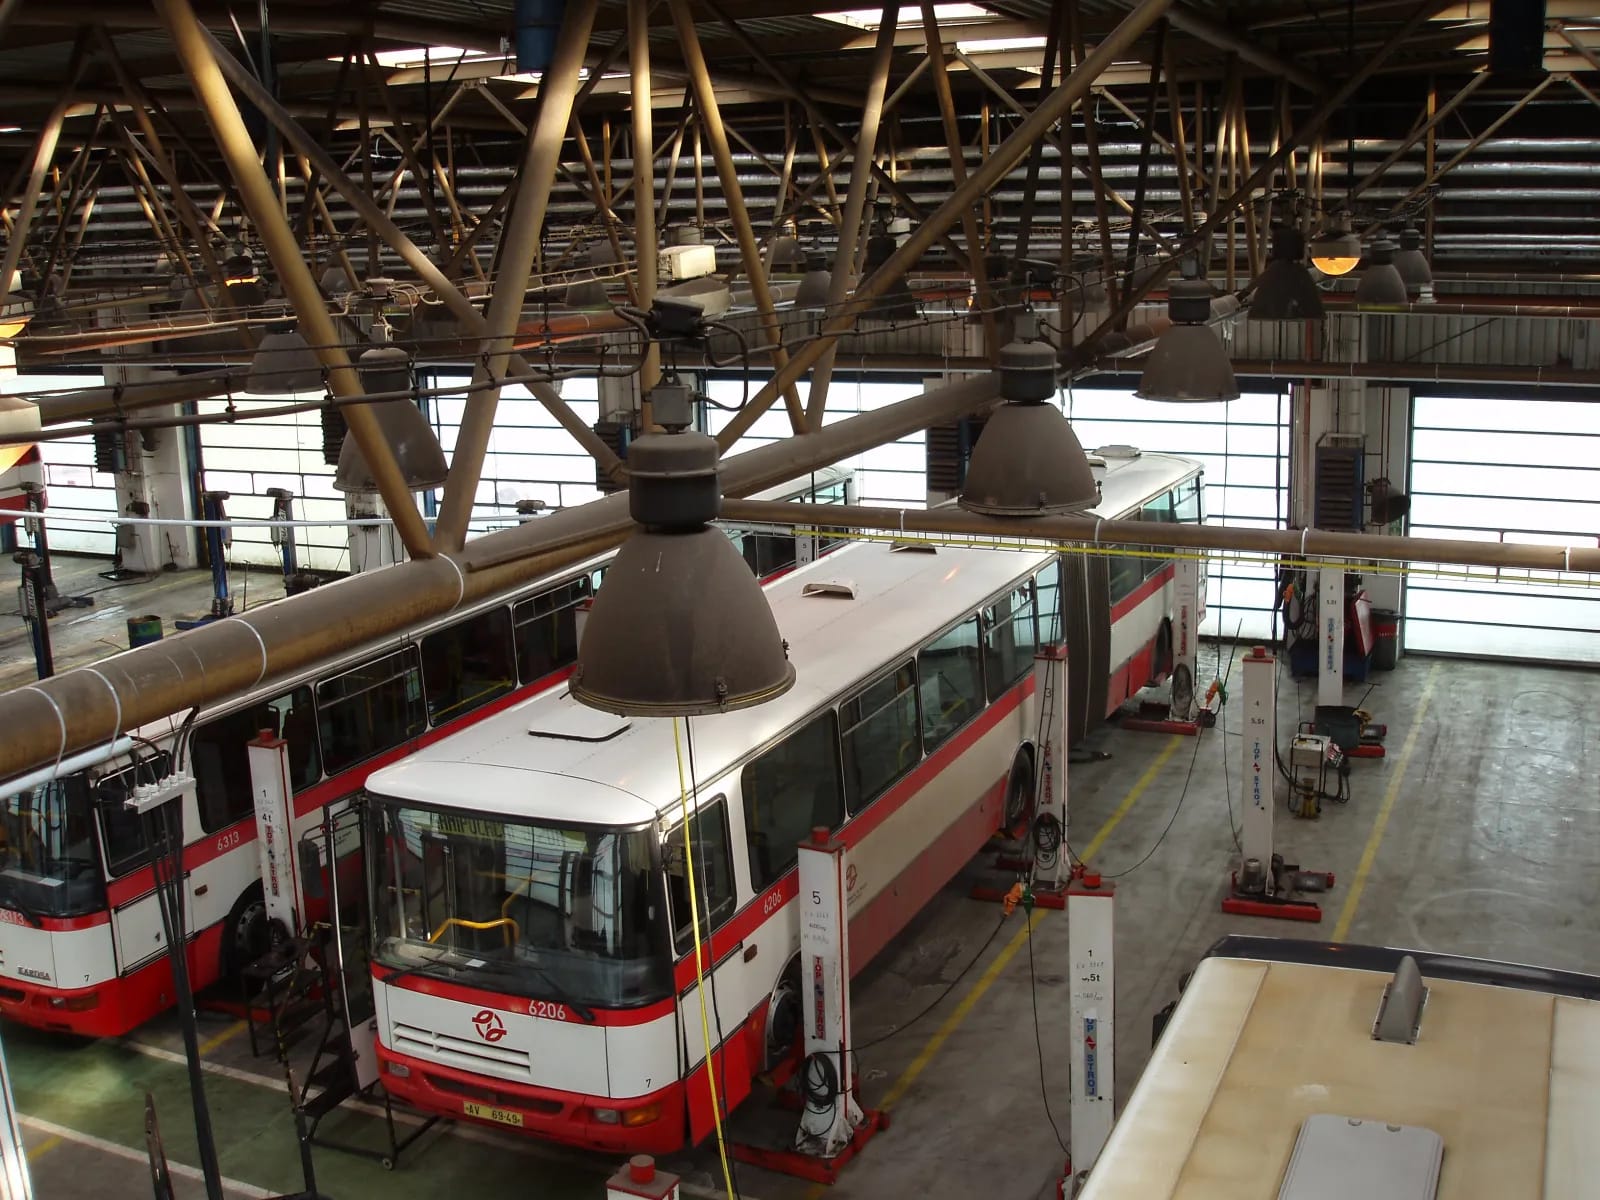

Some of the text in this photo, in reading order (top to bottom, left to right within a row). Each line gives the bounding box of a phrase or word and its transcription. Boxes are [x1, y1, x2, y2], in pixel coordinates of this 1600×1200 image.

[217, 831, 240, 851] 6313
[763, 888, 782, 915] 6206
[811, 890, 821, 905] 5
[84, 974, 90, 983] 7
[528, 999, 566, 1020] 6206
[645, 1078, 652, 1088] 7
[1087, 1054, 1095, 1096] STROJ
[469, 1103, 480, 1116] AV
